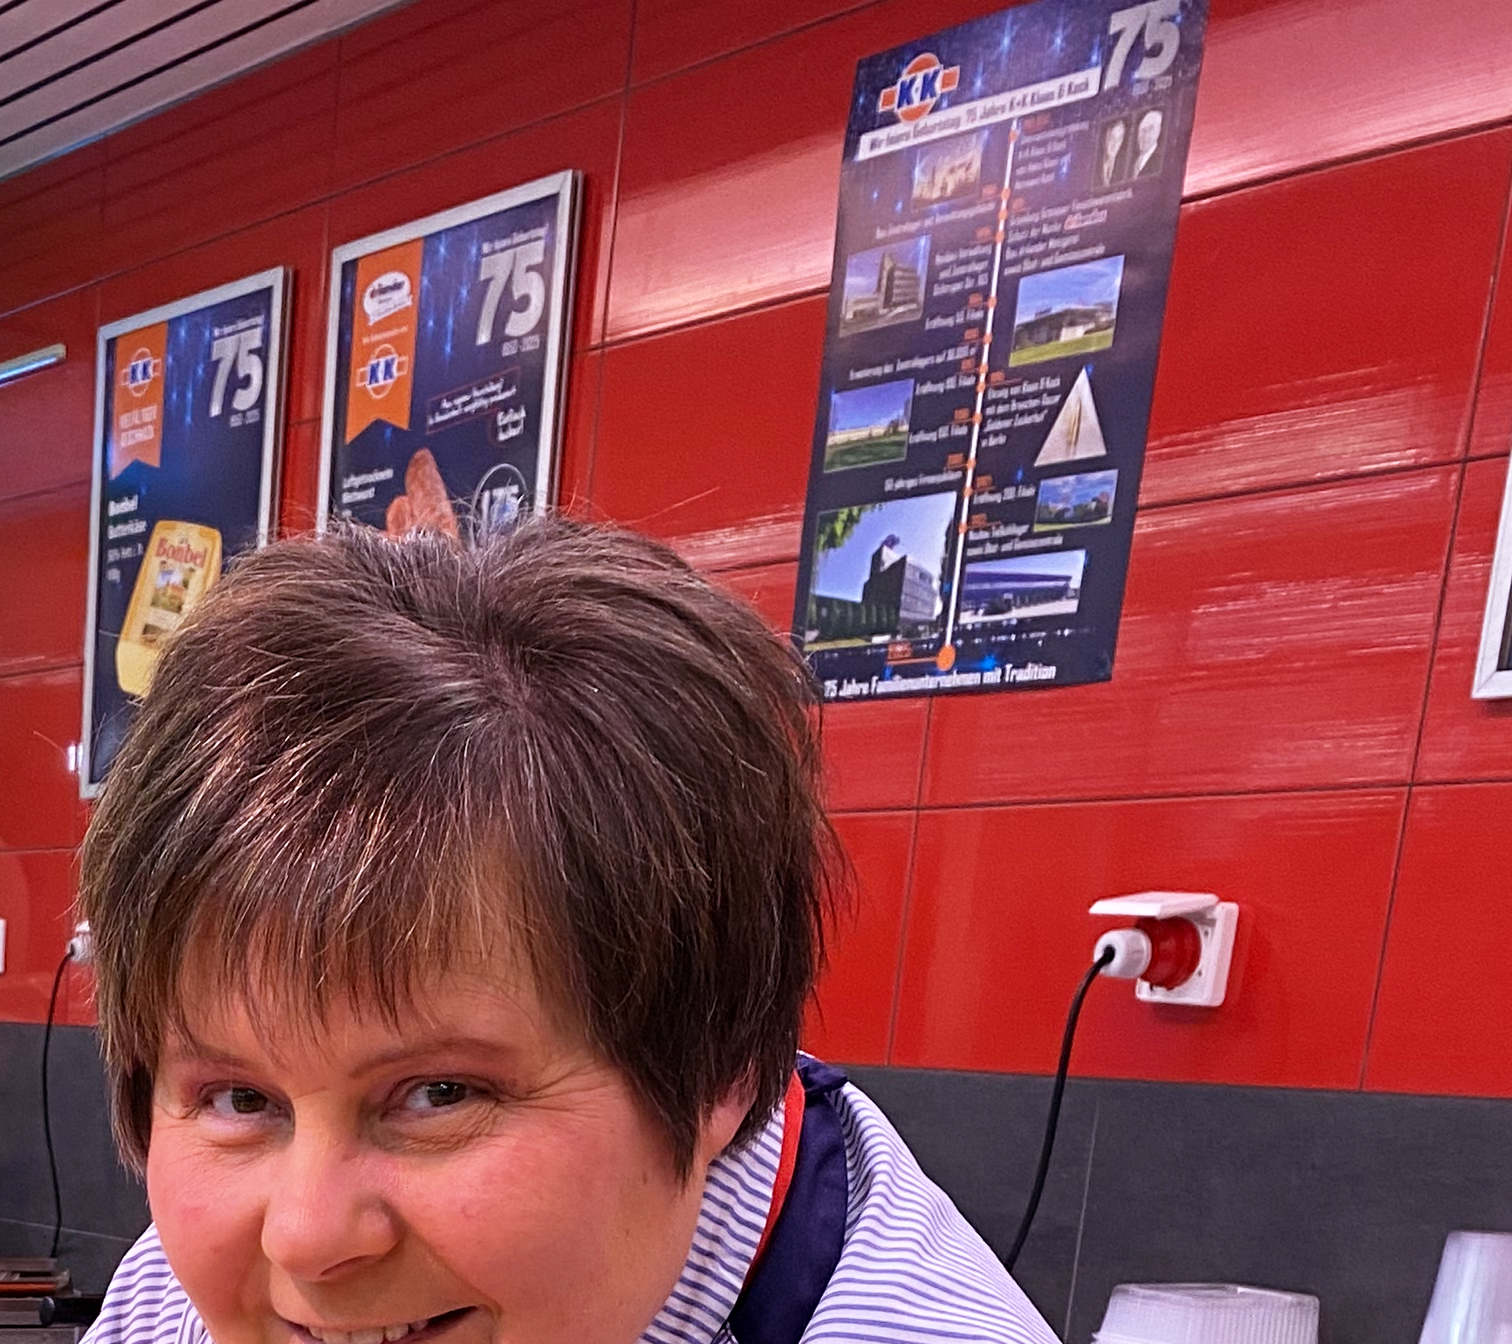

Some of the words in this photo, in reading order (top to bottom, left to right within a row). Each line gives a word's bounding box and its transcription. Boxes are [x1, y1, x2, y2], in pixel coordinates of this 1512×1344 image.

[1104, 0, 1181, 90] 75
[476, 240, 545, 346] 75
[209, 326, 263, 418] 75
[1005, 662, 1057, 682] Tradition
